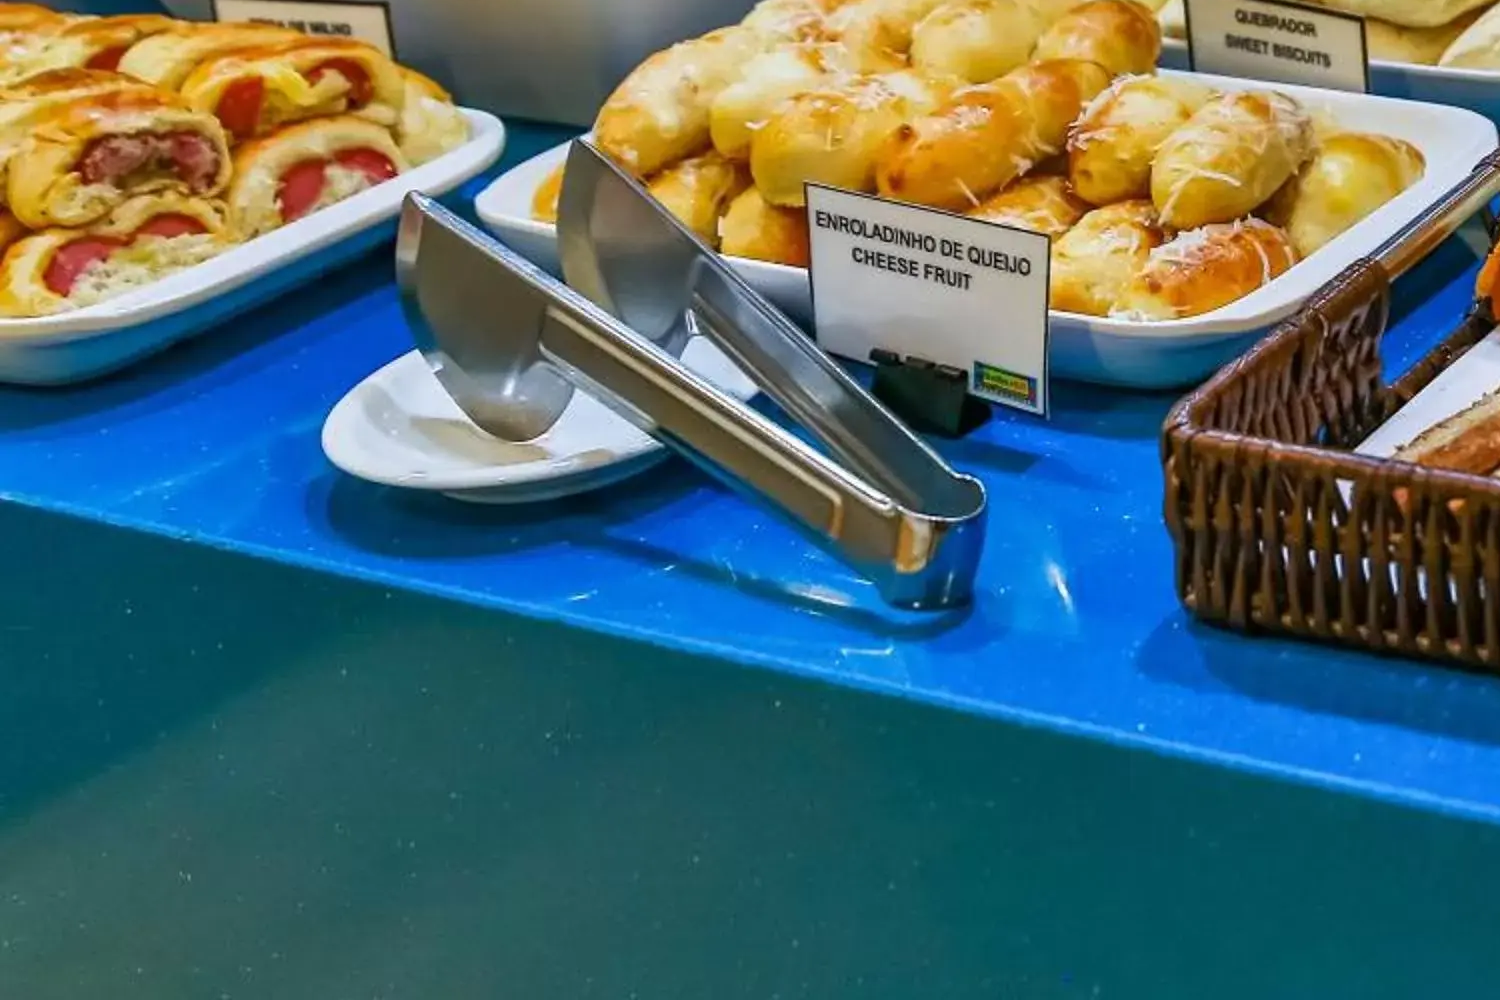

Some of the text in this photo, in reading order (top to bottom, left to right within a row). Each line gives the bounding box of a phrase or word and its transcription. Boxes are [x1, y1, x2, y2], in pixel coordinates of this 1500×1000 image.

[1235, 9, 1317, 37] QUEBRADOR
[1225, 33, 1332, 69] SWEET BISCUITS
[815, 210, 1032, 277] ENROLADINHO DE QUEIJO
[852, 247, 972, 291] CHEESE FRUIT
